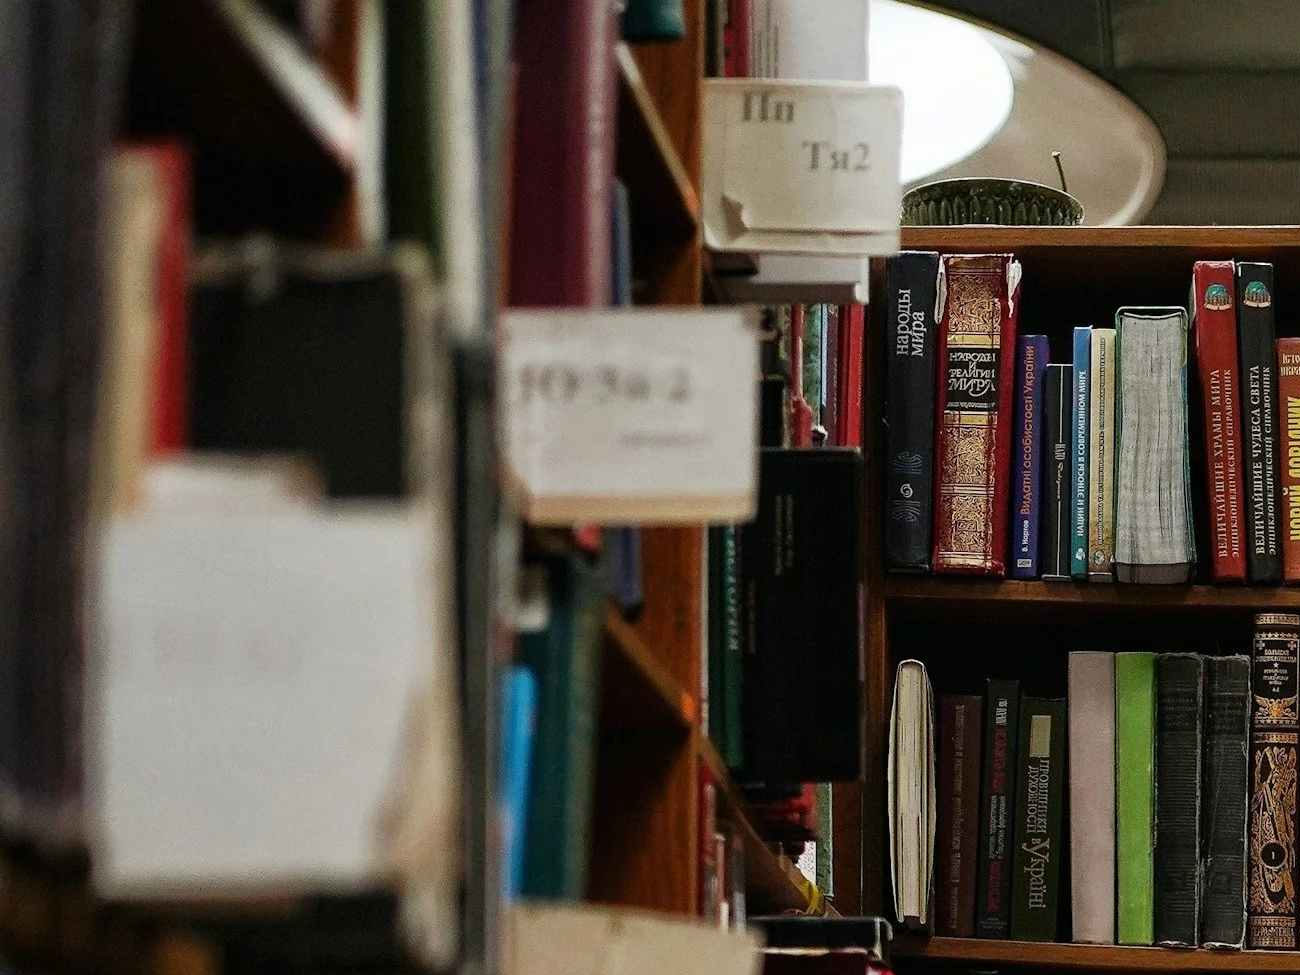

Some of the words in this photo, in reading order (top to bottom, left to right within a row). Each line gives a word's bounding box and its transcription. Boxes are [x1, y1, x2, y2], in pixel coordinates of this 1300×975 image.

[895, 288, 914, 356] народы
[911, 310, 928, 358] мира
[948, 368, 996, 379] РЕЛИГИИ
[949, 352, 996, 363] НАРОДЫ
[1020, 345, 1037, 393] України
[1078, 370, 1087, 393] МИРЕ
[948, 378, 997, 397] МИРА
[1209, 369, 1221, 406] МИРА
[1223, 369, 1234, 436] СПРАВОЧНИК
[1249, 365, 1261, 405] СВЕТА
[1262, 365, 1272, 434] СПРАВОЧНИК
[1077, 393, 1086, 455] СОВРЕМЕННОМ
[1211, 411, 1224, 457] ХРАМЫ
[1250, 407, 1263, 457] ЧУДЕСА
[1018, 470, 1035, 516] Видатні
[1077, 463, 1085, 499] ЭТНОСЫ
[1225, 439, 1240, 558] ЭНЦИКЛОПЕДИЧЕСКИЙ
[1264, 436, 1277, 556] ЭНЦИКЛОПЕДИЧЕСКИЙ
[1076, 506, 1085, 537] НАЦИИ
[1213, 461, 1229, 558] ВЕЛИЧАЙШИЕ
[1251, 461, 1266, 555] ВЕЛИЧАЙШИЕ
[1026, 764, 1040, 835] ДУХОВНОСТІ
[1037, 759, 1051, 835] ПРОВІДНИКИ
[1022, 838, 1050, 909] Україні
